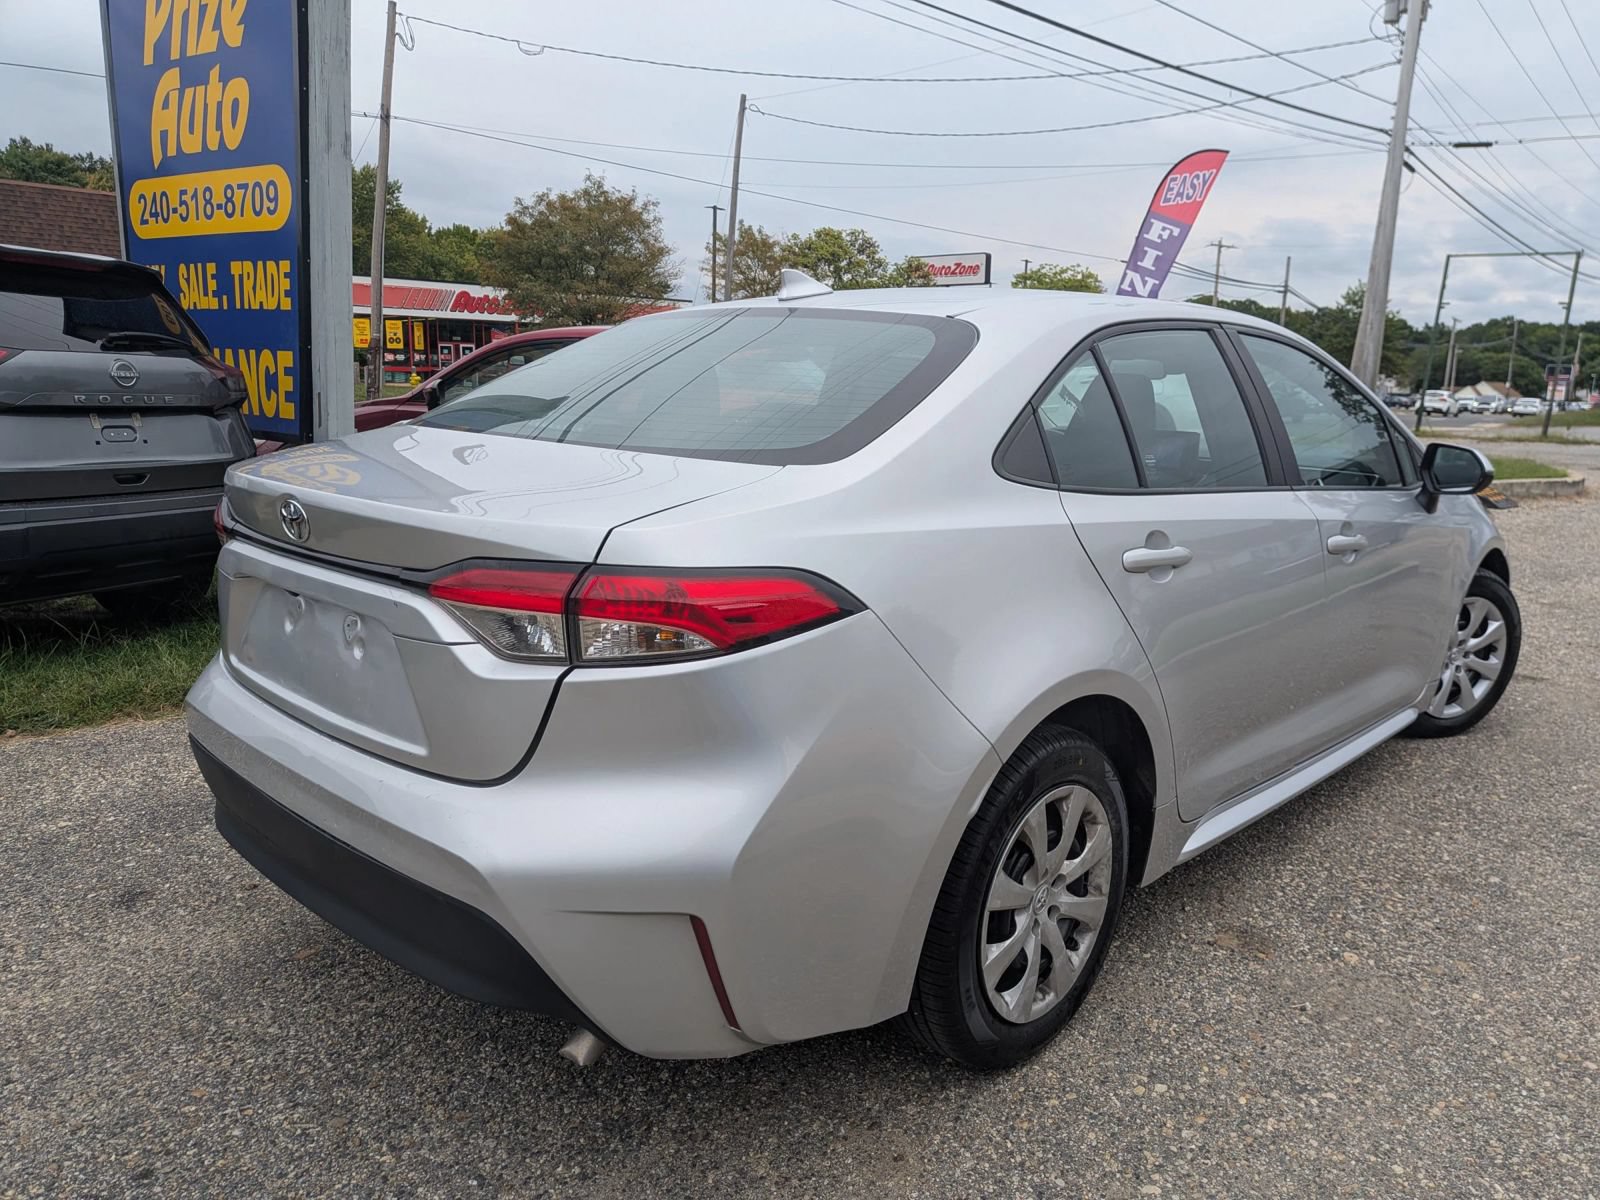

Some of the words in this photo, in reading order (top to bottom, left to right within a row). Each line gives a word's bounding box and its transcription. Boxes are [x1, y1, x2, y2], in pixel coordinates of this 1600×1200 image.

[143, 0, 246, 66] Prize
[151, 63, 250, 170] Auto
[138, 179, 279, 226] 240-518-8709
[1160, 169, 1217, 206] EASY
[1120, 218, 1181, 298] FIN
[230, 260, 292, 310] TRADE
[73, 394, 175, 405] ROGUE
